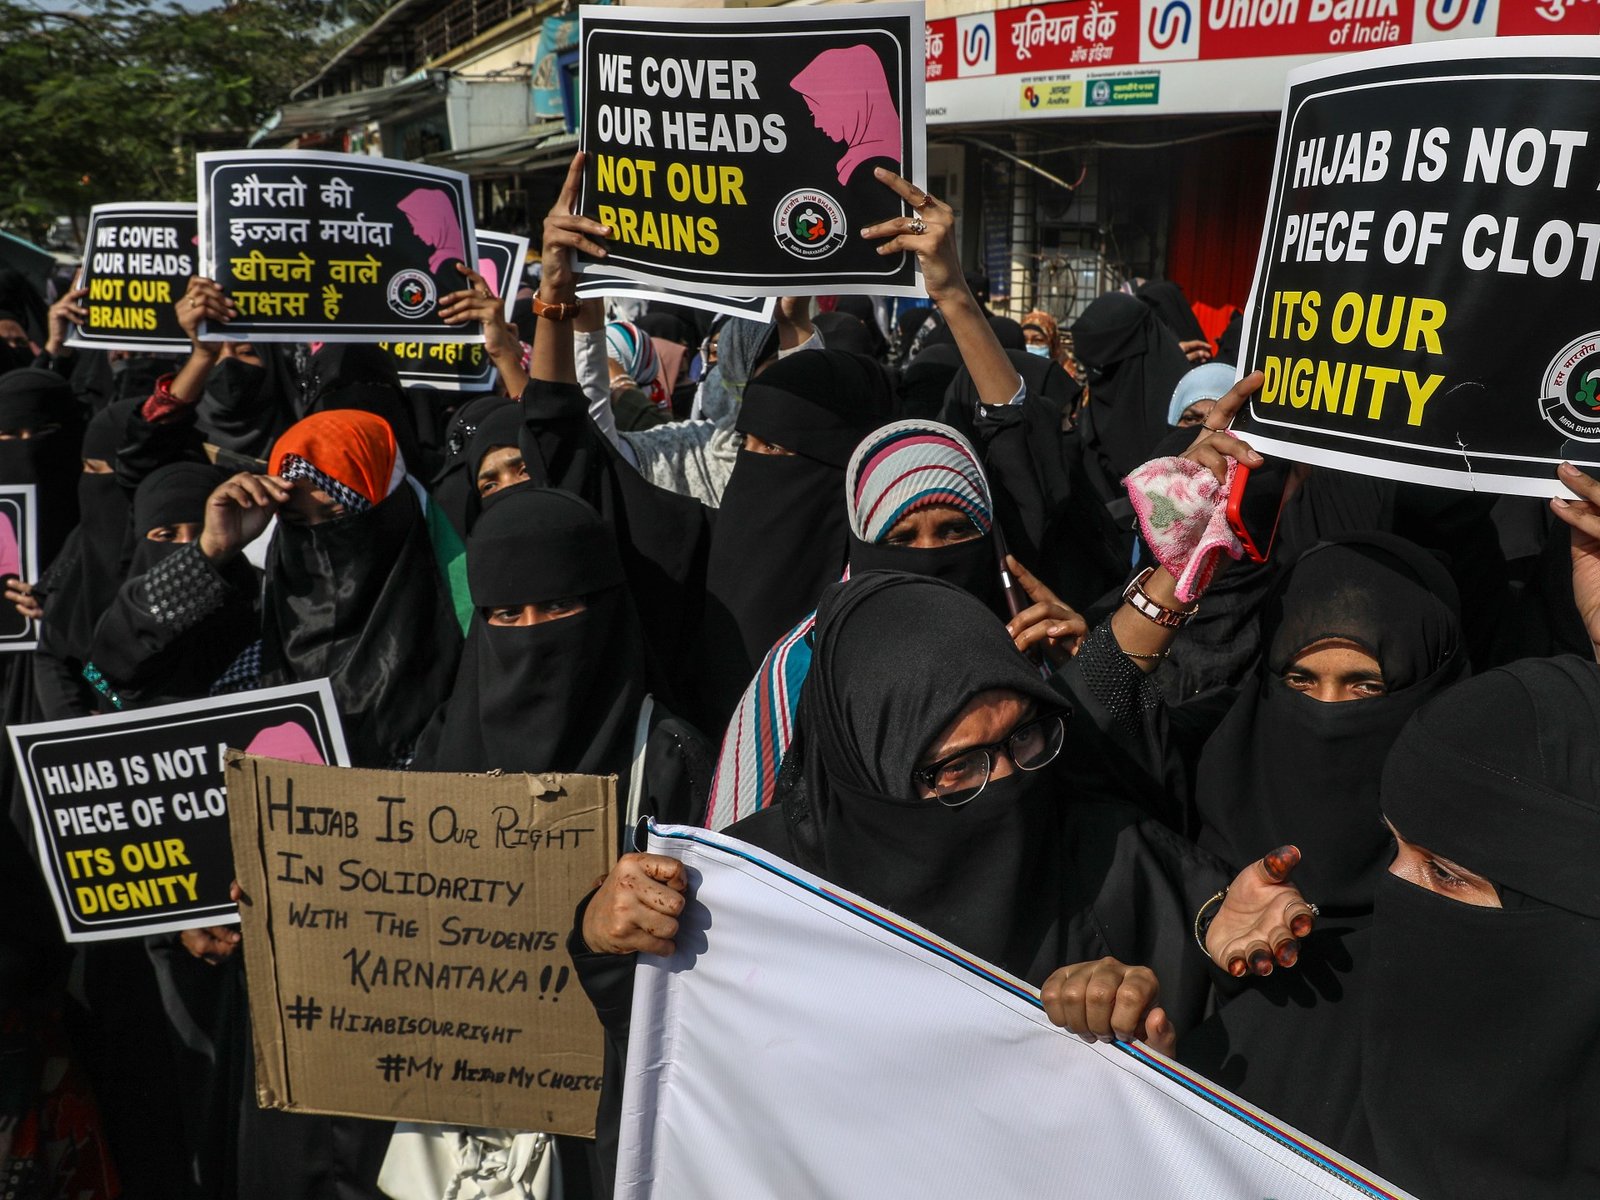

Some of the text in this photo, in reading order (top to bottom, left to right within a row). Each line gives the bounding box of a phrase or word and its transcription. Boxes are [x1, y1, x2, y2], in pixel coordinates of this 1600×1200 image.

[1011, 0, 1119, 60] यूनियन बैंक
[1208, 0, 1300, 30] Union
[1329, 21, 1400, 45] of India
[1088, 42, 1114, 63] इंडिया
[599, 53, 760, 100] WE COVER
[598, 104, 787, 154] OUR HEADS
[1293, 127, 1588, 189] HIJAB IS NOT
[229, 173, 354, 209] औरतो की
[598, 154, 748, 206] NOT OUR
[319, 212, 393, 247] मर्यादा
[817, 197, 839, 225] BHARTIYA
[96, 226, 179, 249] WE COVER
[599, 205, 720, 256] BRAINS
[1280, 209, 1600, 282] PIECE OF CLOT
[92, 252, 193, 276] OUR HEADS
[230, 249, 315, 282] खीचने
[328, 253, 382, 284] वाले
[89, 278, 172, 303] NOT OUR
[232, 283, 343, 320] राक्षस है
[89, 305, 157, 330] BRAINS
[1269, 290, 1447, 355] ITS OUR
[1563, 343, 1596, 369] भारतीय
[1260, 355, 1445, 427] DIGNITY
[1559, 415, 1575, 430] MIRA
[42, 760, 118, 796] HIJAB
[121, 756, 150, 786] IS
[152, 746, 208, 781] NOT
[54, 786, 227, 837] PIECE OF CLO
[65, 838, 191, 879] ITS OUR
[76, 872, 198, 915] DIGNITY
